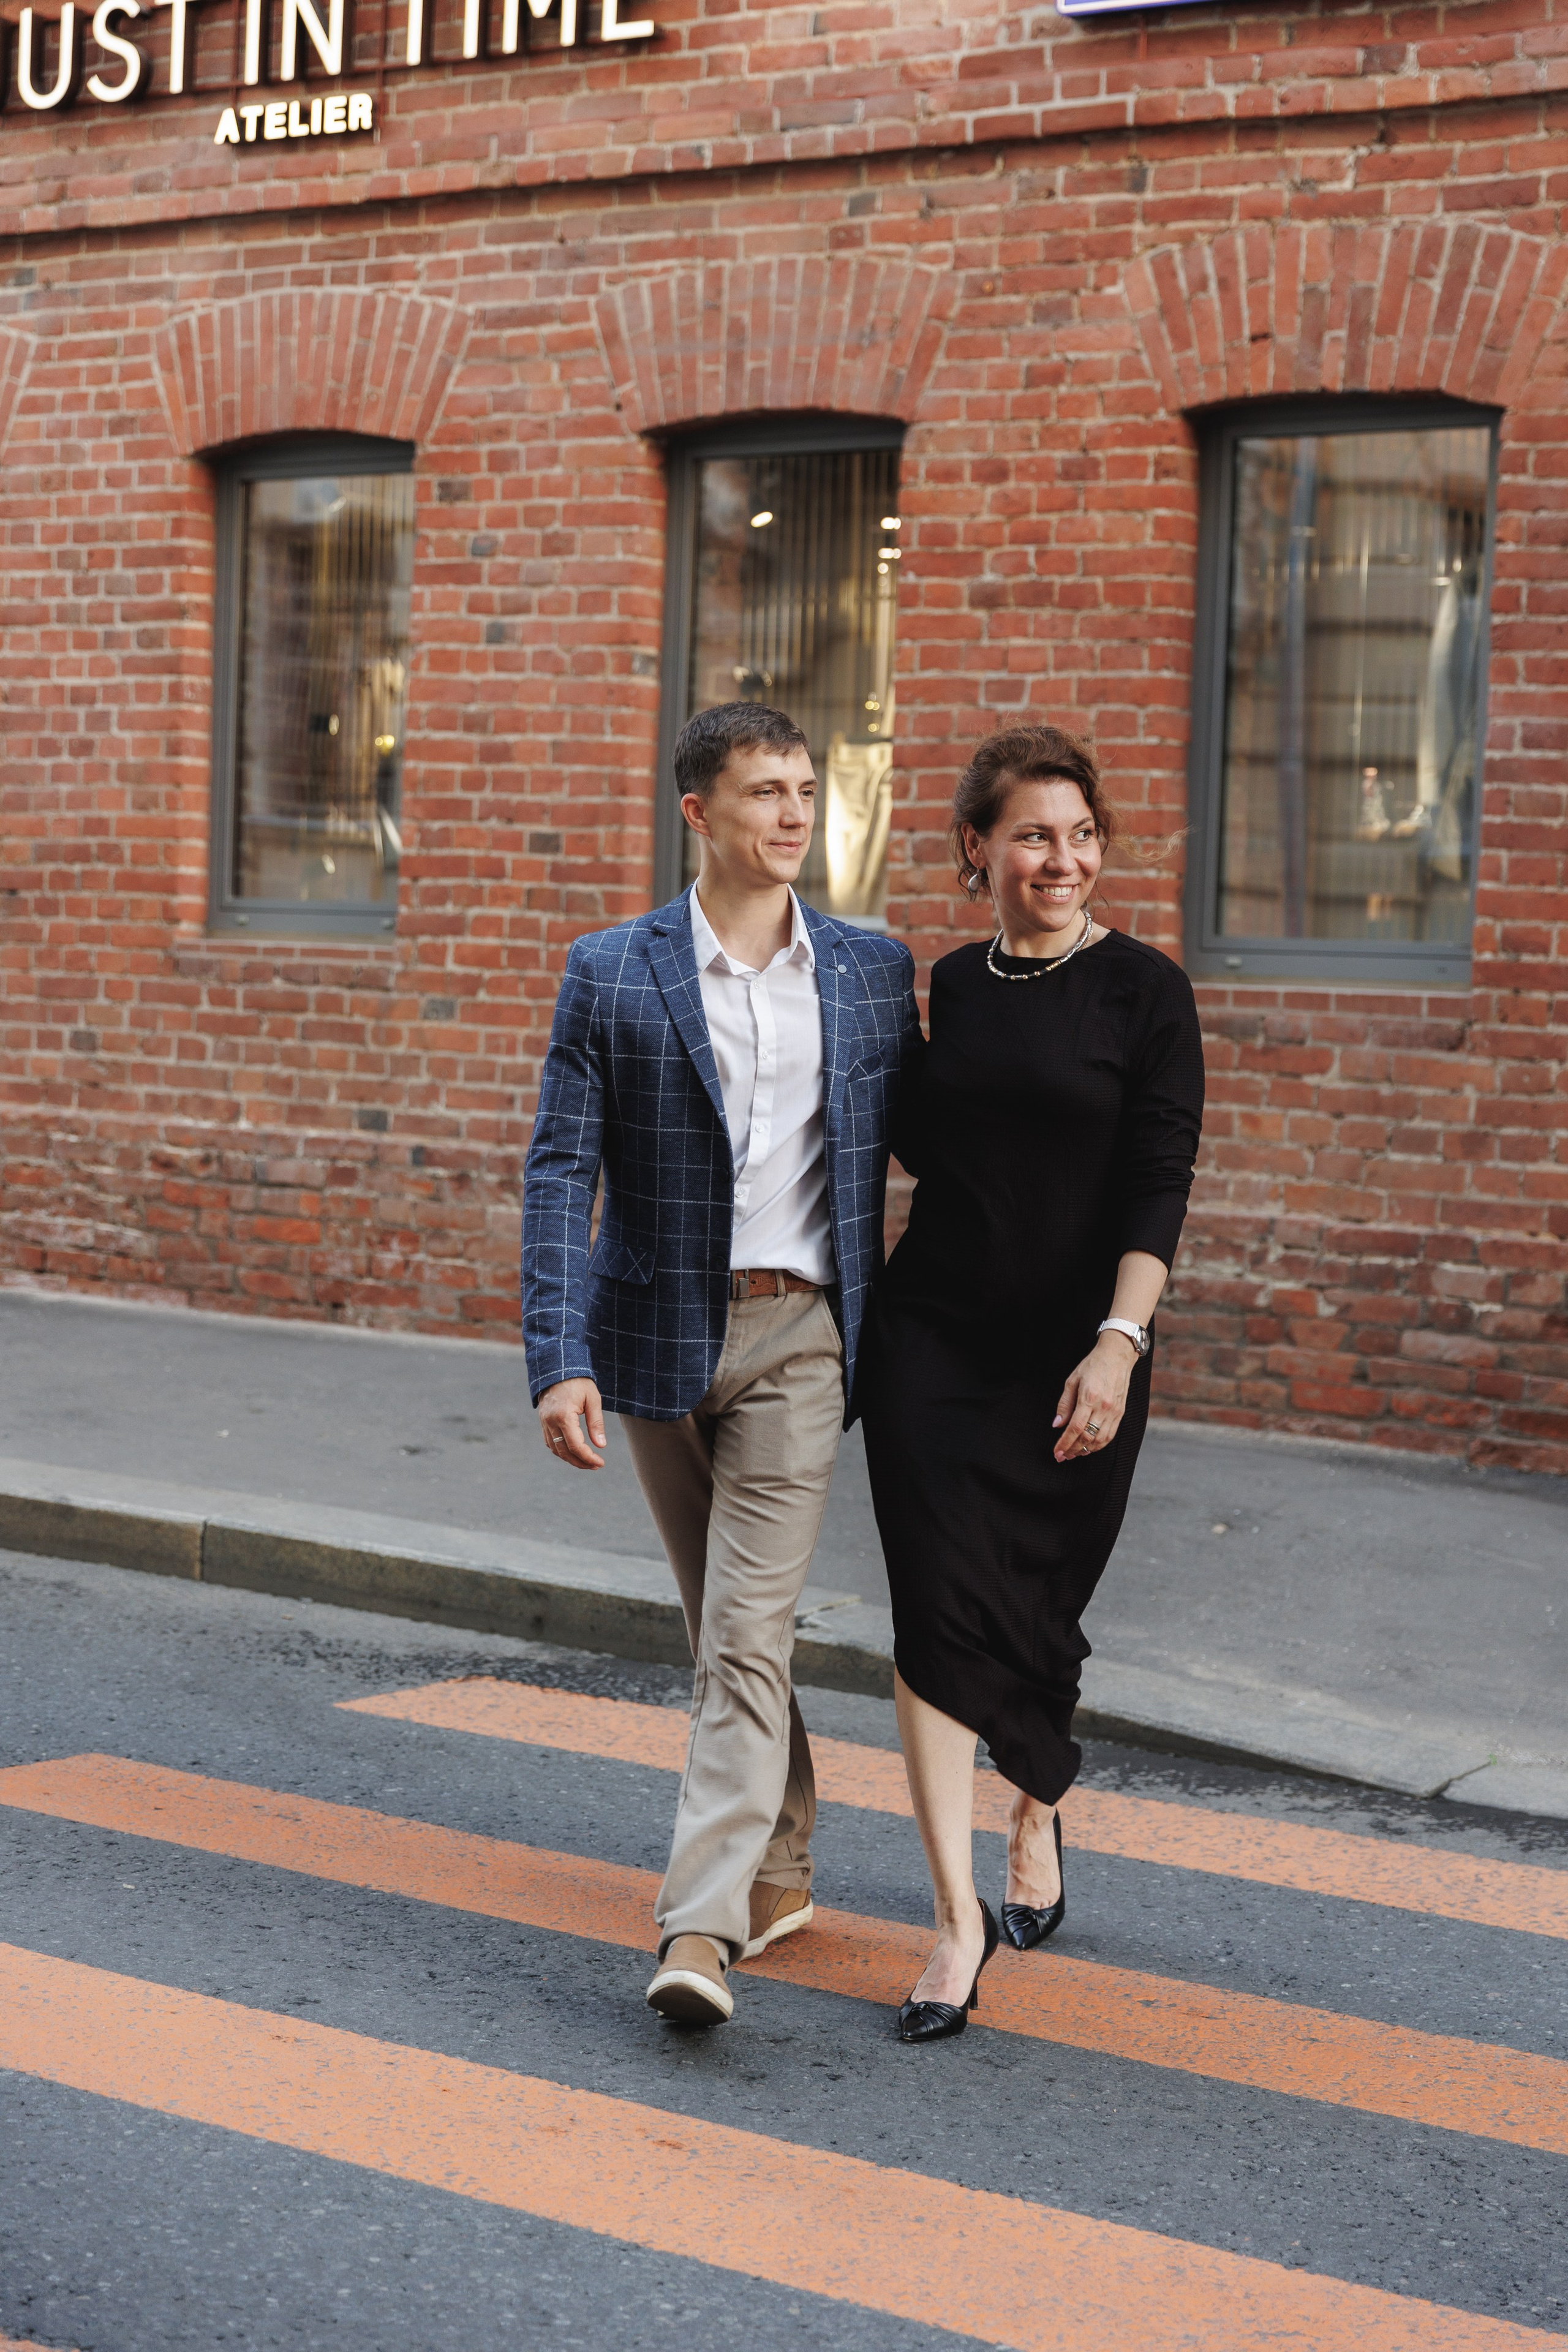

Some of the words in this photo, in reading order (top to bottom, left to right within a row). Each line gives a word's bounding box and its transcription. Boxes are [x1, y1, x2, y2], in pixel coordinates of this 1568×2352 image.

[18, 0, 202, 110] UST
[244, 0, 344, 86] IN
[214, 92, 373, 145] ATELIER
